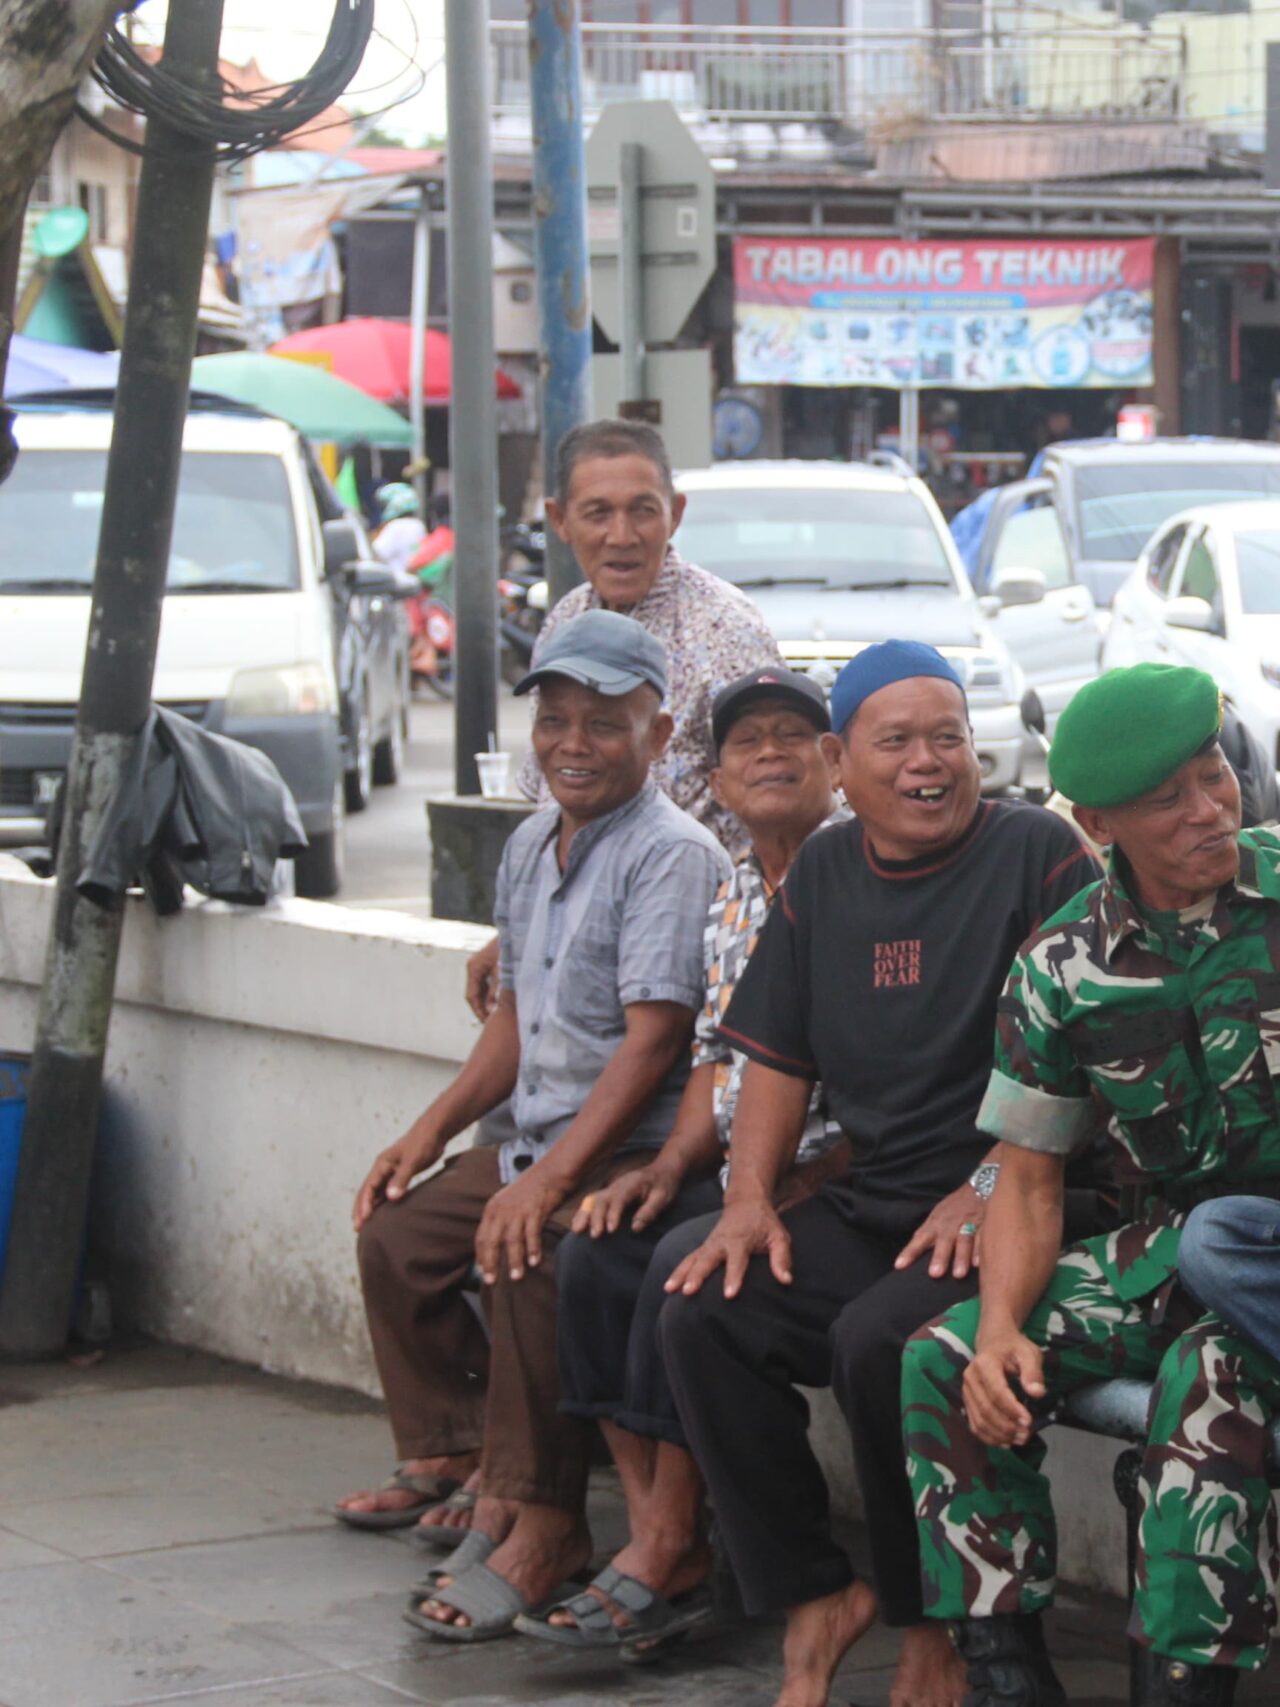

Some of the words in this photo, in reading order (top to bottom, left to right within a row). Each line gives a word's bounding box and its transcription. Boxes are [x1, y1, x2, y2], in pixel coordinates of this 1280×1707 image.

[745, 247, 964, 286] TABALONG
[974, 247, 1127, 286] TEKNIK
[874, 940, 921, 958] FAITH
[874, 952, 920, 974] OVER
[874, 966, 920, 987] FEAR
